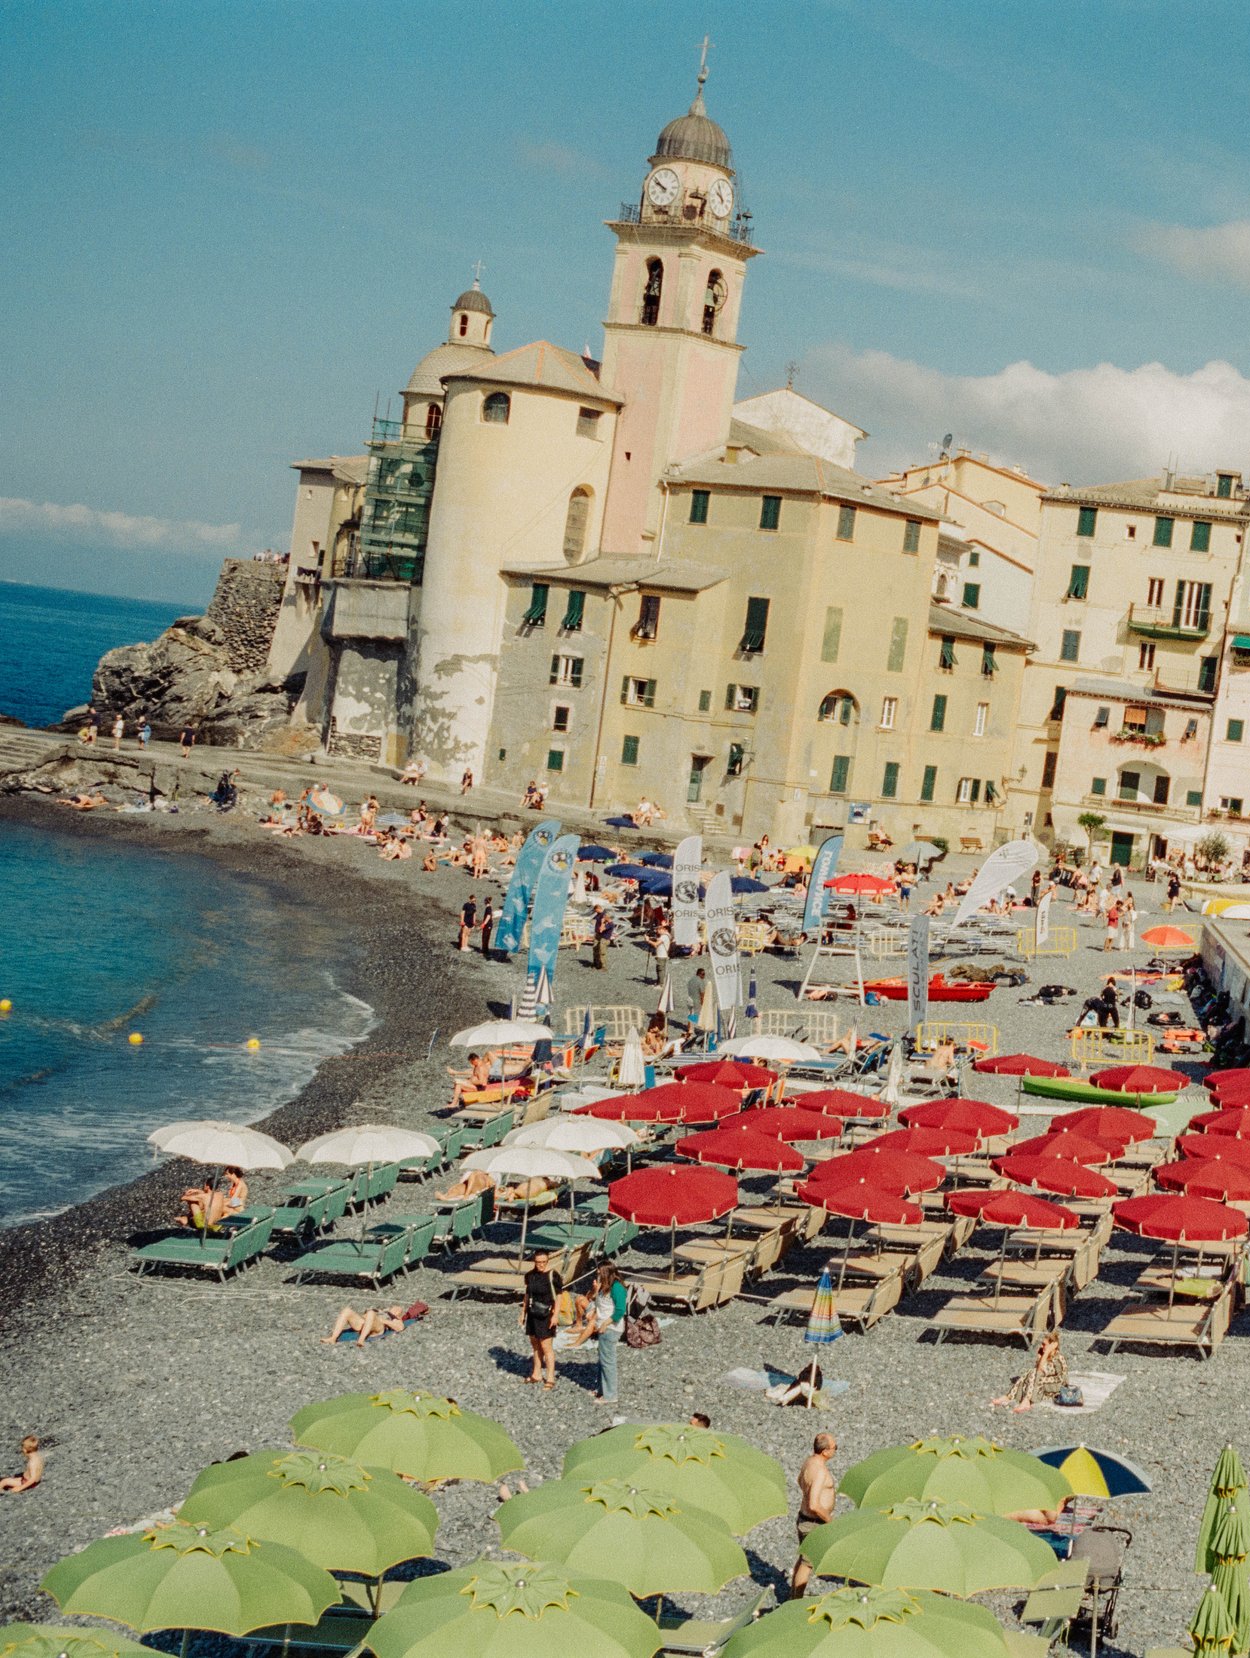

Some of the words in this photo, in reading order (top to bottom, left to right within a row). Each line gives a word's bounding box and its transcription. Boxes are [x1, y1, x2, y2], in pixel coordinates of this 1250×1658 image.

[675, 864, 700, 873] ORIS
[674, 909, 697, 918] ORIS
[707, 906, 734, 919] ORIS
[715, 965, 740, 976] ORIS
[911, 930, 921, 1011] SCULATI
